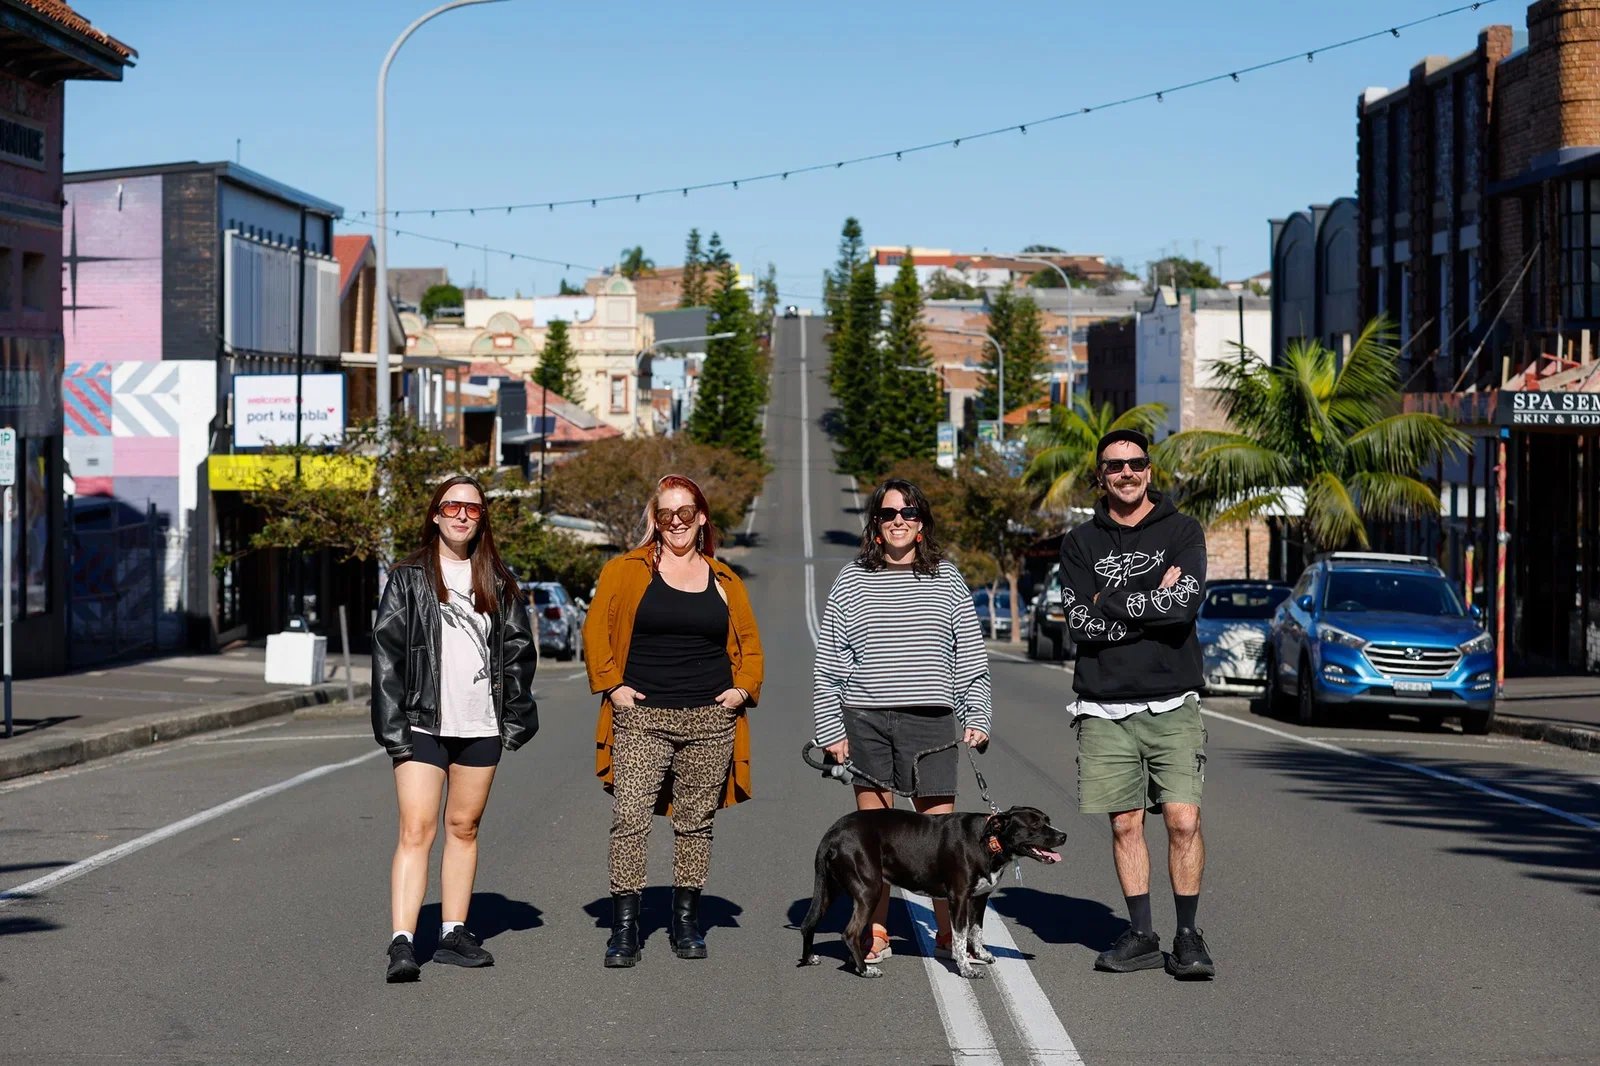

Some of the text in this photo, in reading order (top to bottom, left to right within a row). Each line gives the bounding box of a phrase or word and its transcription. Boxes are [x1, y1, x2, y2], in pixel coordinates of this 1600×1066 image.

[247, 395, 291, 404] welcome
[1513, 393, 1555, 410] SPA
[247, 410, 274, 424] port
[1513, 413, 1550, 424] SKIN
[1554, 414, 1565, 424] &
